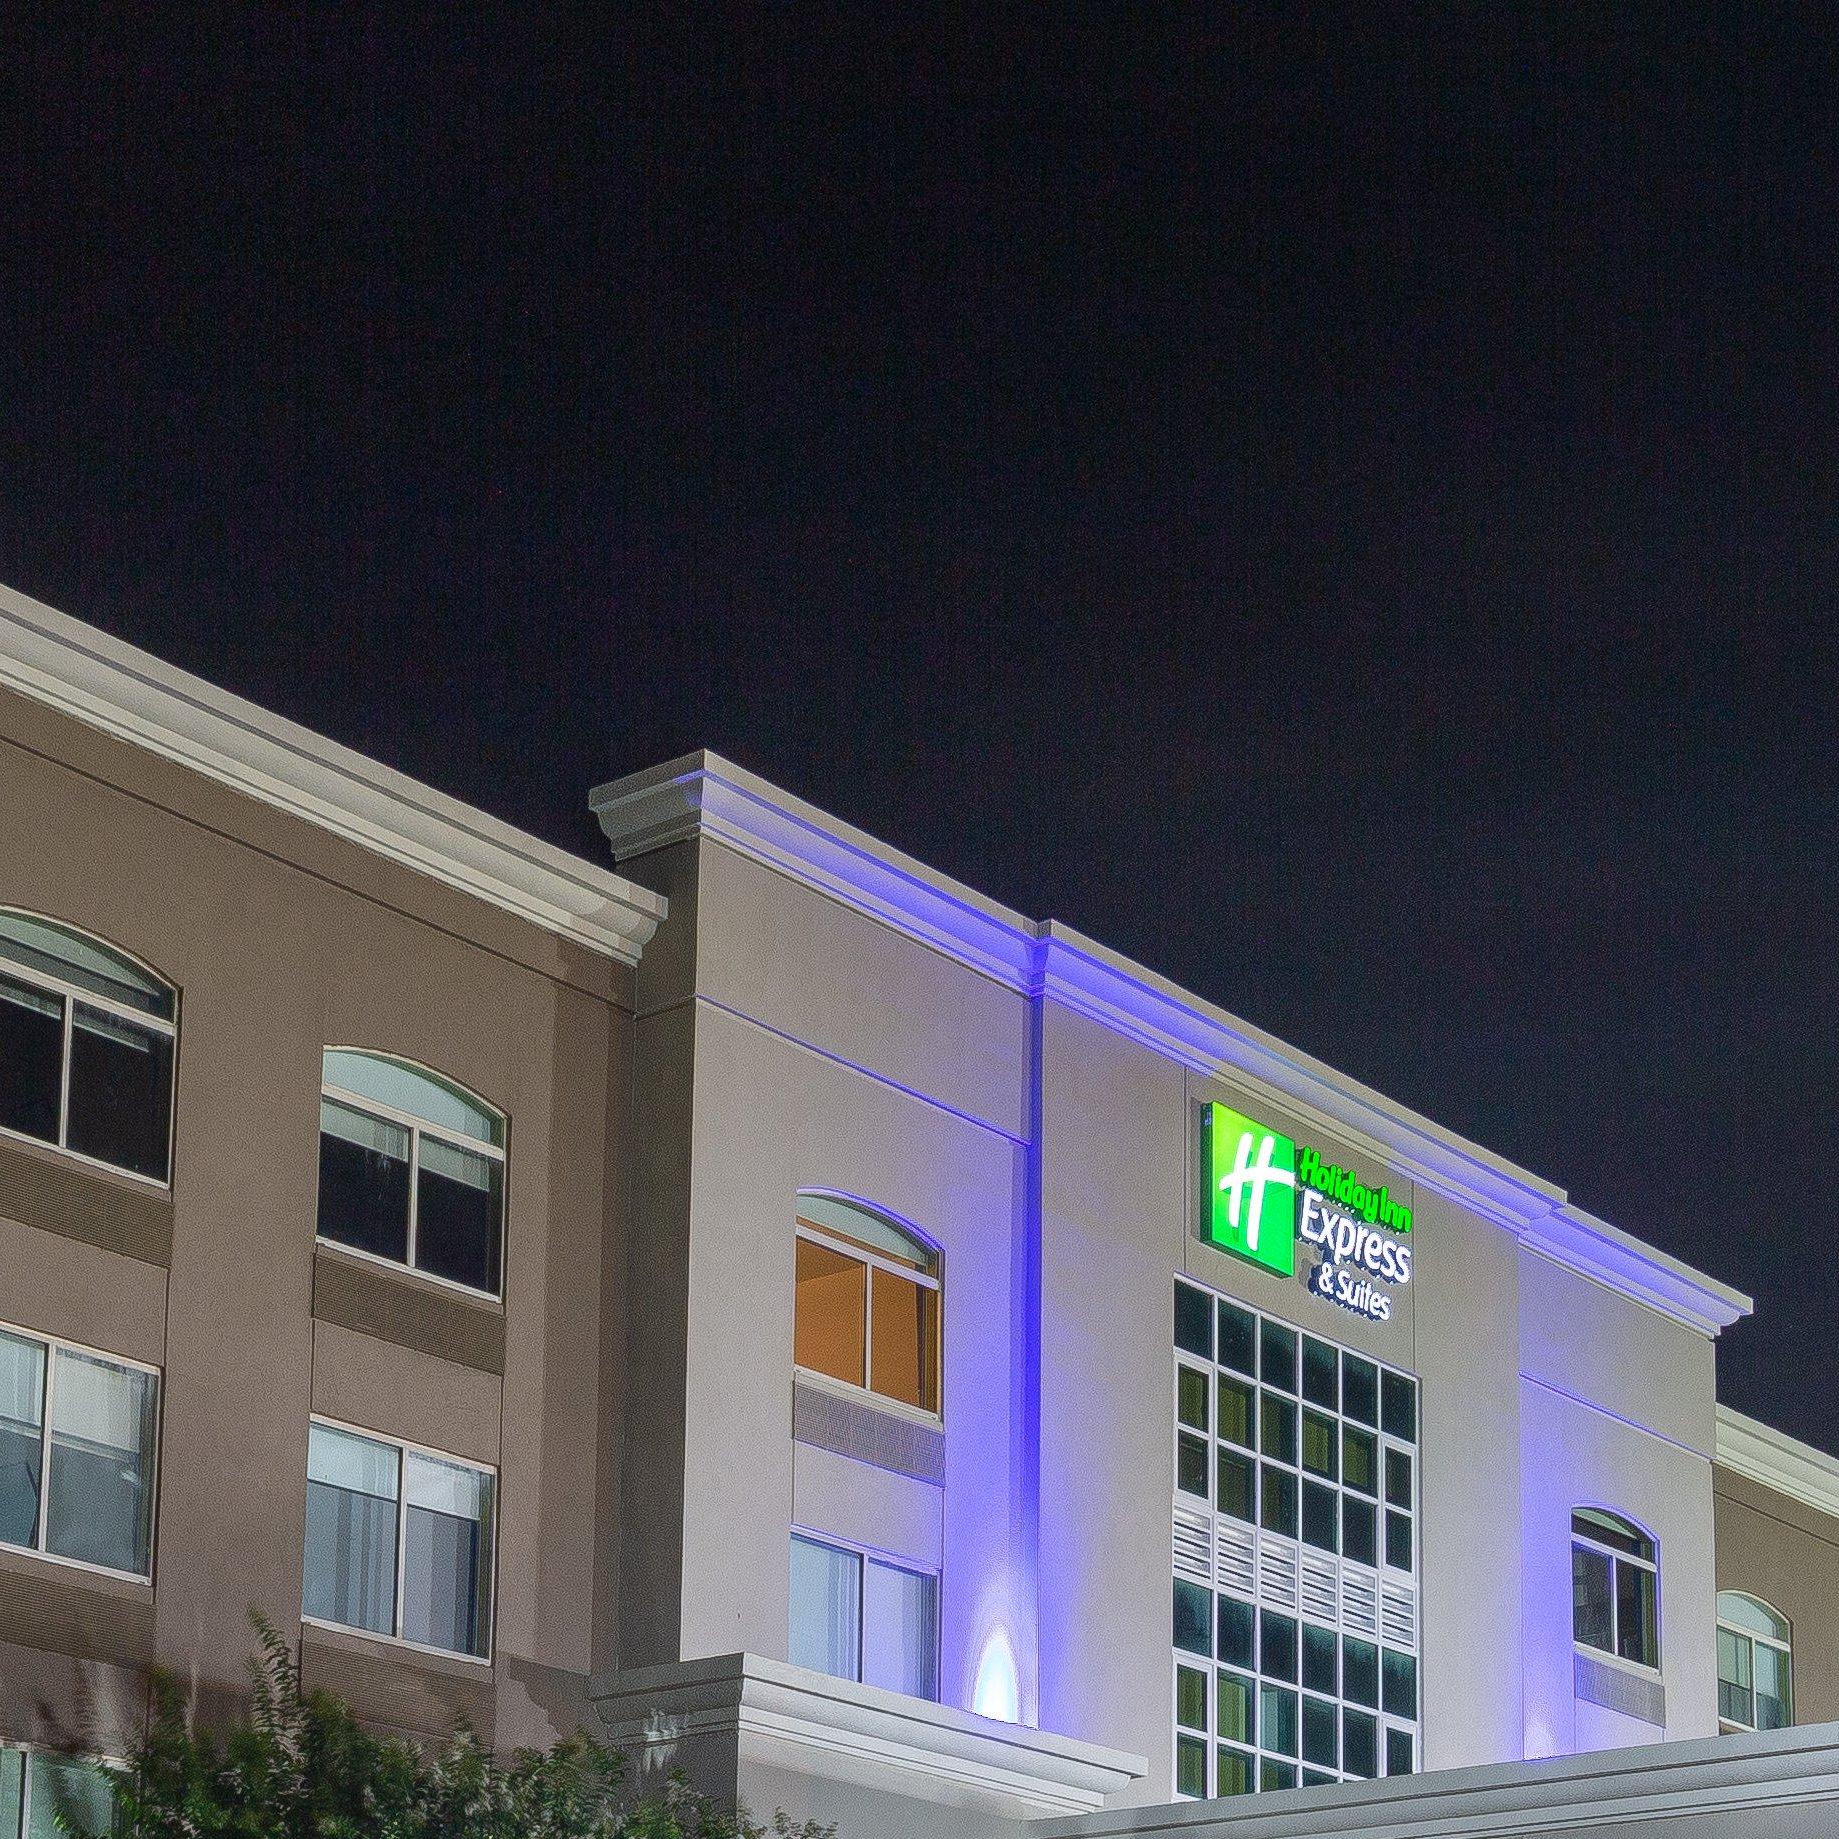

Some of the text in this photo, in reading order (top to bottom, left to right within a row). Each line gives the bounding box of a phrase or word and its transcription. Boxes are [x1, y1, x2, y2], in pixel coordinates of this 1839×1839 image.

[1300, 1146, 1412, 1233] Holiday Inn
[1301, 1188, 1411, 1284] Express
[1318, 1261, 1391, 1320] & Suites
